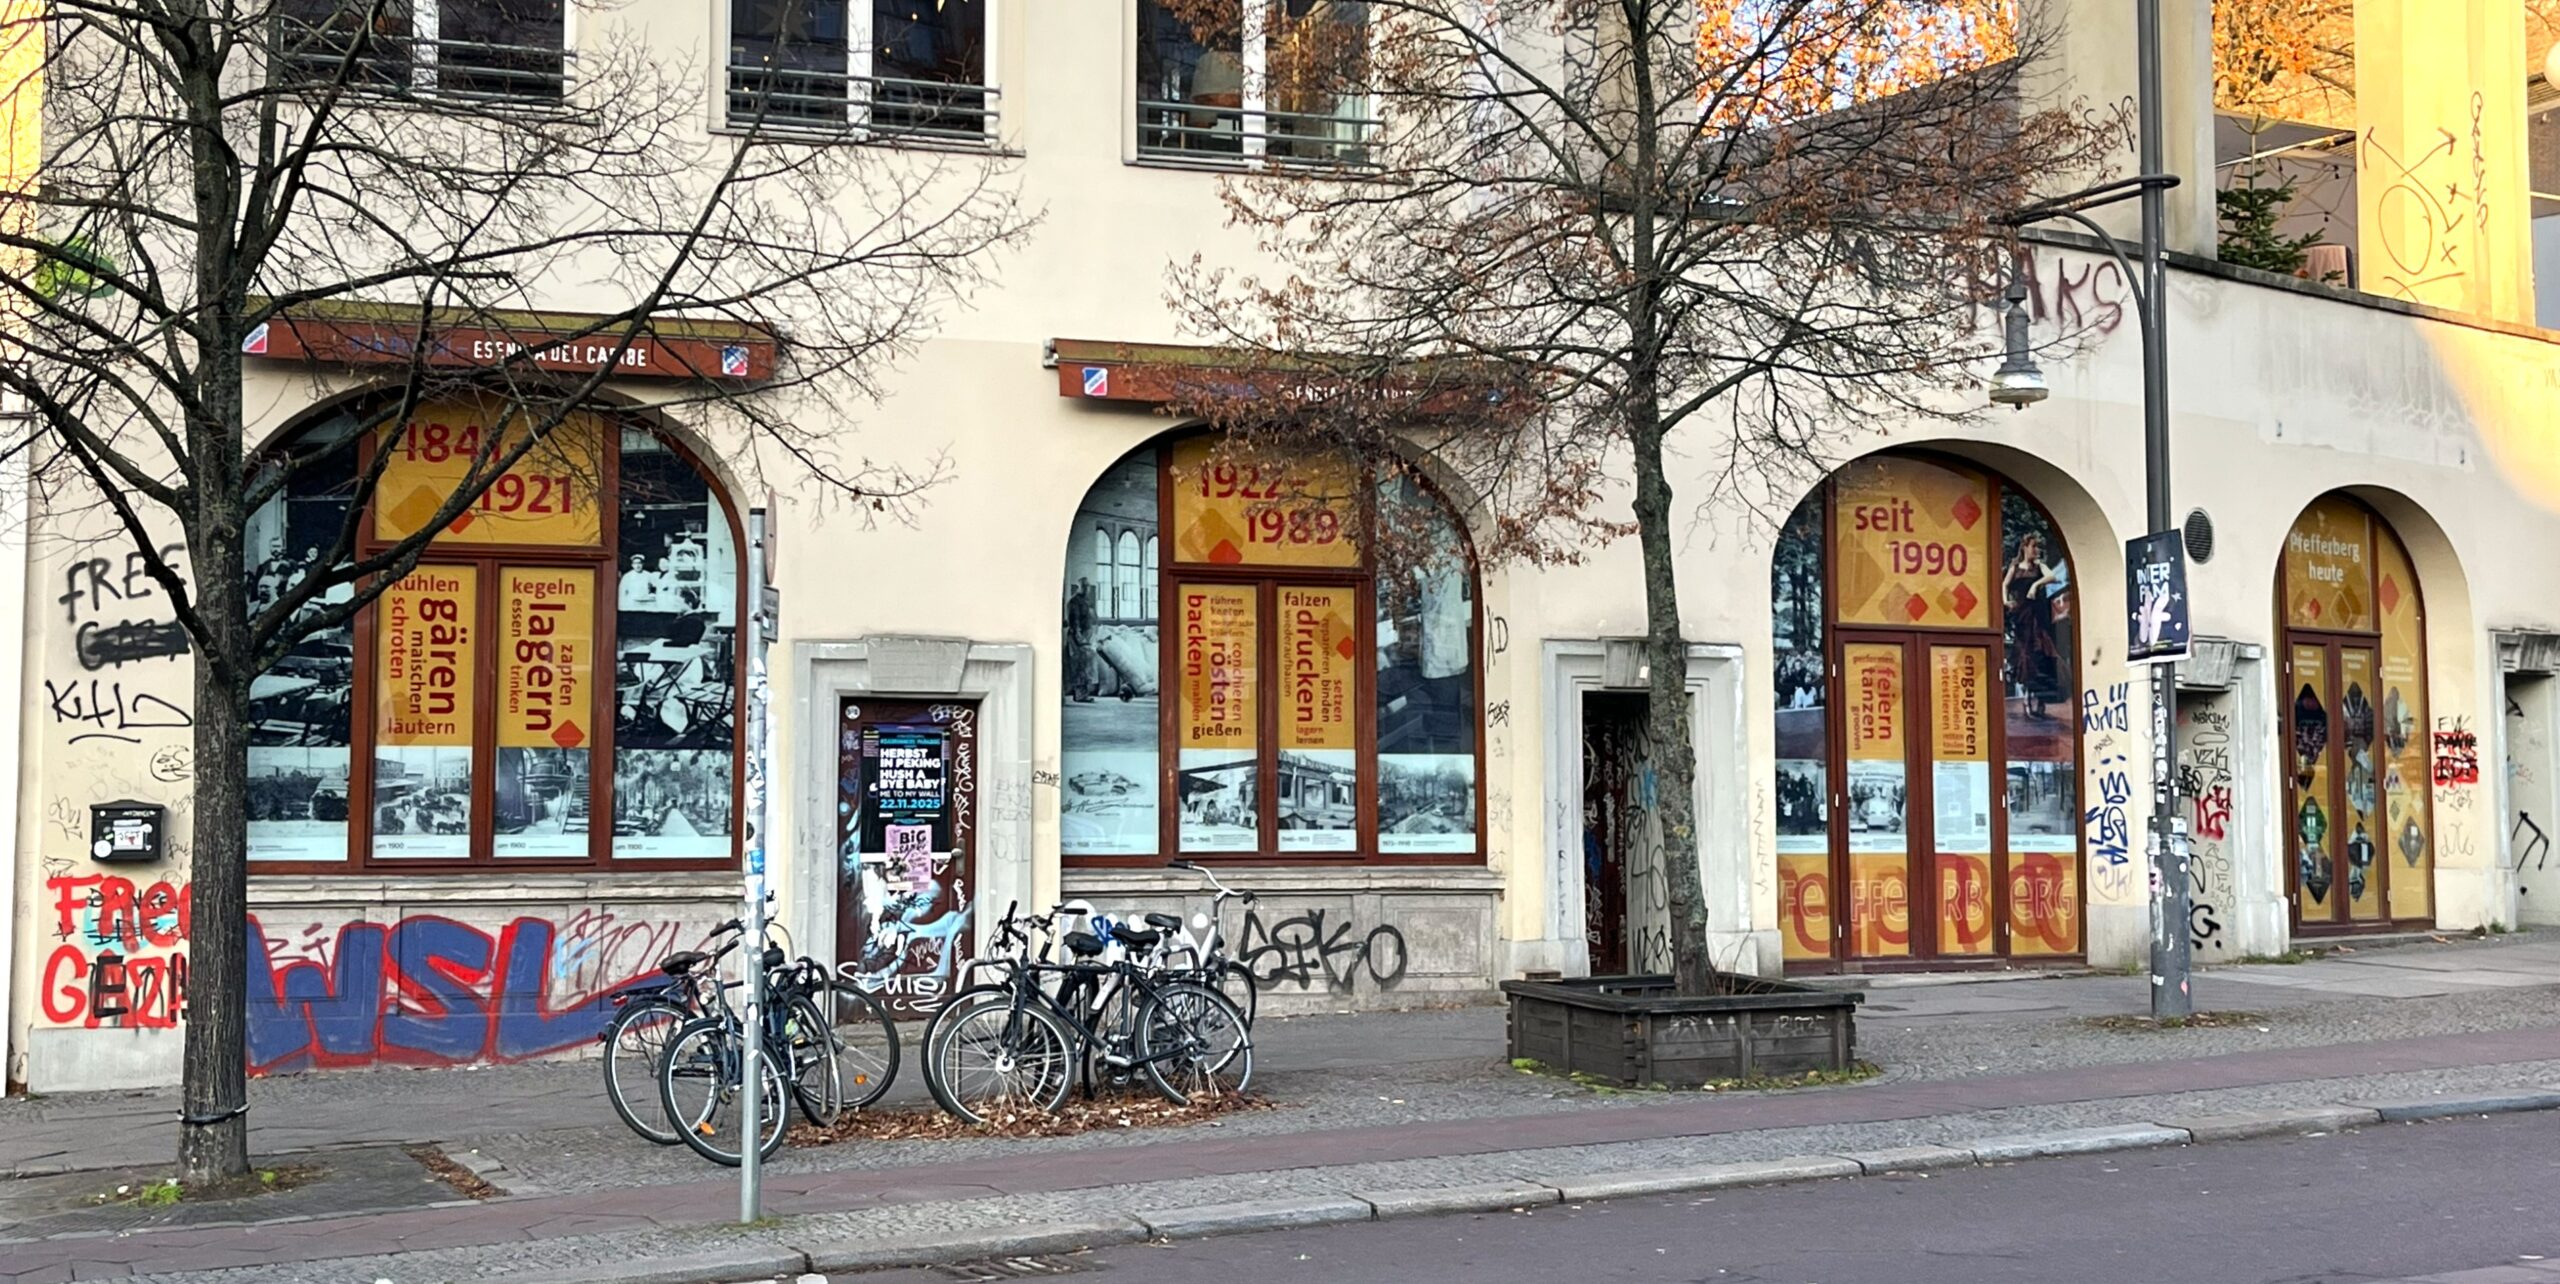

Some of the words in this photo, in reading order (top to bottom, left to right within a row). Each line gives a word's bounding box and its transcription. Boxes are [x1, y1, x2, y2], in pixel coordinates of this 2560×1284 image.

[1247, 508, 1339, 545] 1989
[1855, 497, 1915, 533] seit
[1888, 541, 1968, 577] 1990
[2290, 531, 2361, 563] Pfefferberg
[393, 575, 460, 592] kühlen
[512, 576, 576, 599] kegeln
[2308, 560, 2344, 582] heute
[511, 598, 523, 638] essen
[1284, 592, 1332, 607] falzen
[390, 596, 410, 679] schroten
[1187, 594, 1207, 677] backen
[409, 631, 427, 714] maischen
[418, 597, 468, 715] gären
[515, 603, 567, 732] lagern
[1296, 609, 1321, 723] drucken
[508, 665, 524, 714] trinken
[559, 644, 577, 706] zapfen
[1210, 642, 1232, 721] rösten
[1320, 679, 1333, 723] binden
[1333, 679, 1345, 723] setzen
[1861, 667, 1876, 740] tanzen
[1877, 666, 1897, 740] feiern
[1960, 655, 1979, 755] engagieren
[388, 718, 456, 735] läutern
[1192, 722, 1242, 740] gießen
[880, 748, 928, 759] HERBST
[880, 758, 893, 768] IN
[895, 758, 941, 768] PEKING
[880, 769, 914, 779] HUSH
[916, 769, 926, 779] A
[880, 779, 904, 789] BYE
[906, 779, 940, 789] BABY
[880, 799, 940, 809] 22.11.2025
[918, 790, 940, 798] WALL
